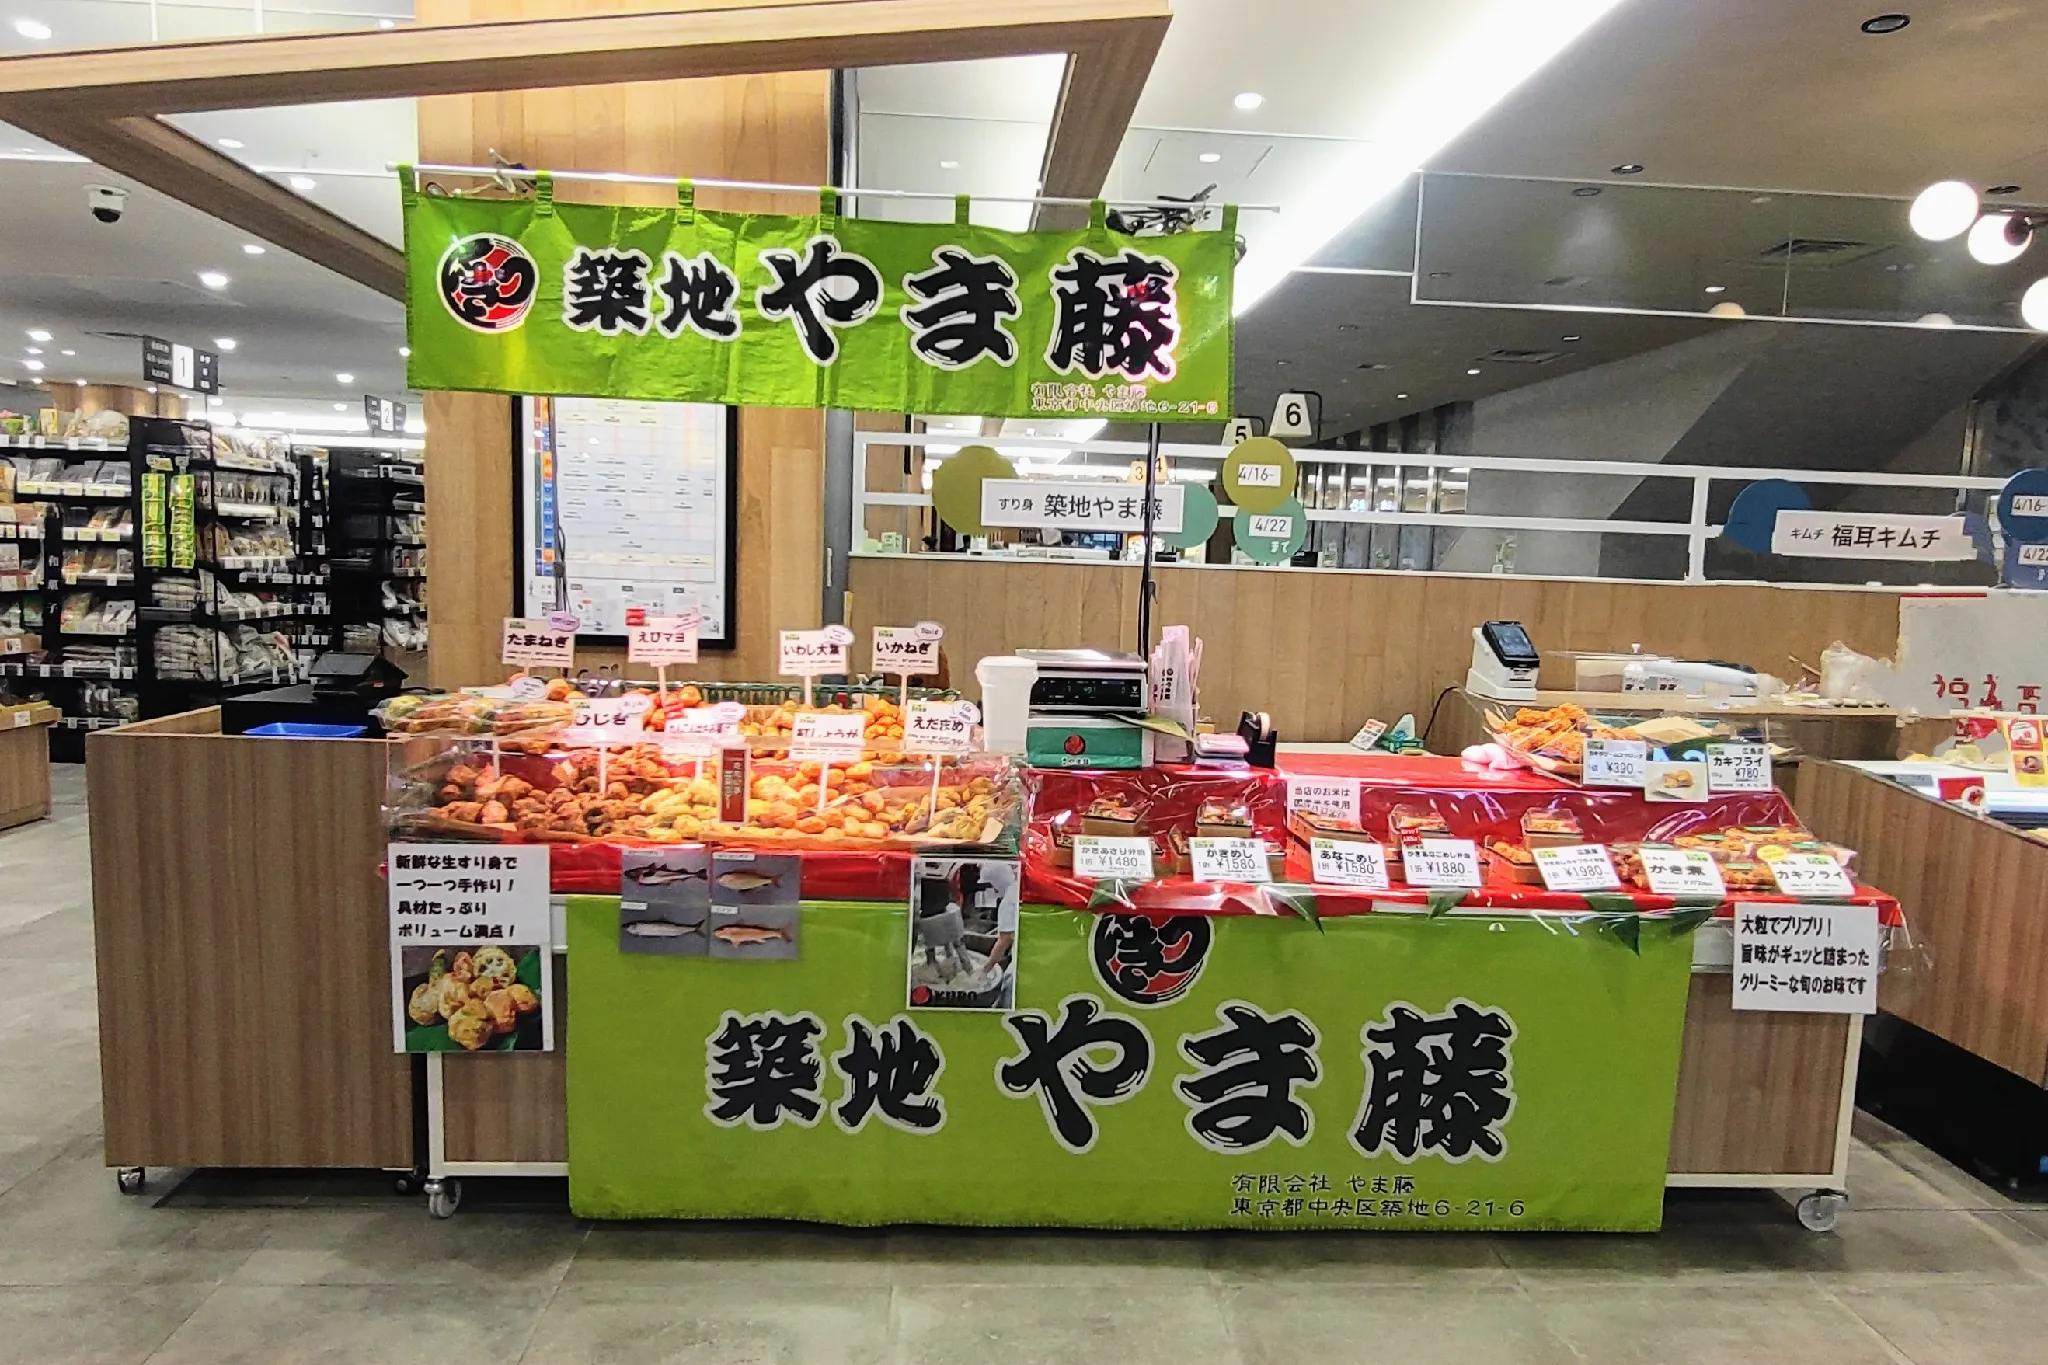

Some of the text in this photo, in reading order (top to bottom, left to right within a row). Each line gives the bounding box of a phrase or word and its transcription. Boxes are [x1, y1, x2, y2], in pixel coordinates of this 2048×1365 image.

[564, 236, 1178, 382] 築地やま藤
[1286, 402, 1302, 426] 6
[1235, 425, 1247, 444] 5
[1135, 466, 1144, 480] 3
[999, 498, 1034, 511] すり身
[1255, 518, 1286, 532] 4/22
[1790, 523, 1941, 549] キムチ 福耳キムチ
[507, 633, 569, 649] たまねぎ
[638, 631, 684, 643] えびマヨ
[876, 641, 931, 655] いかねぎ
[1713, 756, 1763, 767] カキフライ
[1206, 848, 1254, 859] かきめし
[396, 854, 518, 870] 新鮮な生すり身で
[1098, 855, 1138, 867] ¥1480
[1216, 858, 1256, 870] ¥1580
[1336, 861, 1375, 874] ¥1580
[1426, 861, 1466, 874] ¥1880
[1777, 869, 1843, 880] カキフライ
[397, 900, 488, 915] 具材たっぷり
[1741, 944, 1870, 967] 旨味がギュッと詰まった
[1740, 972, 1867, 995] クリーミーな旬のお味です
[704, 995, 1516, 1159] 築地やま藤
[1231, 1174, 1415, 1194] 有限会社 やま藤
[1231, 1197, 1525, 1218] 東京都中央区築地6-21-6
